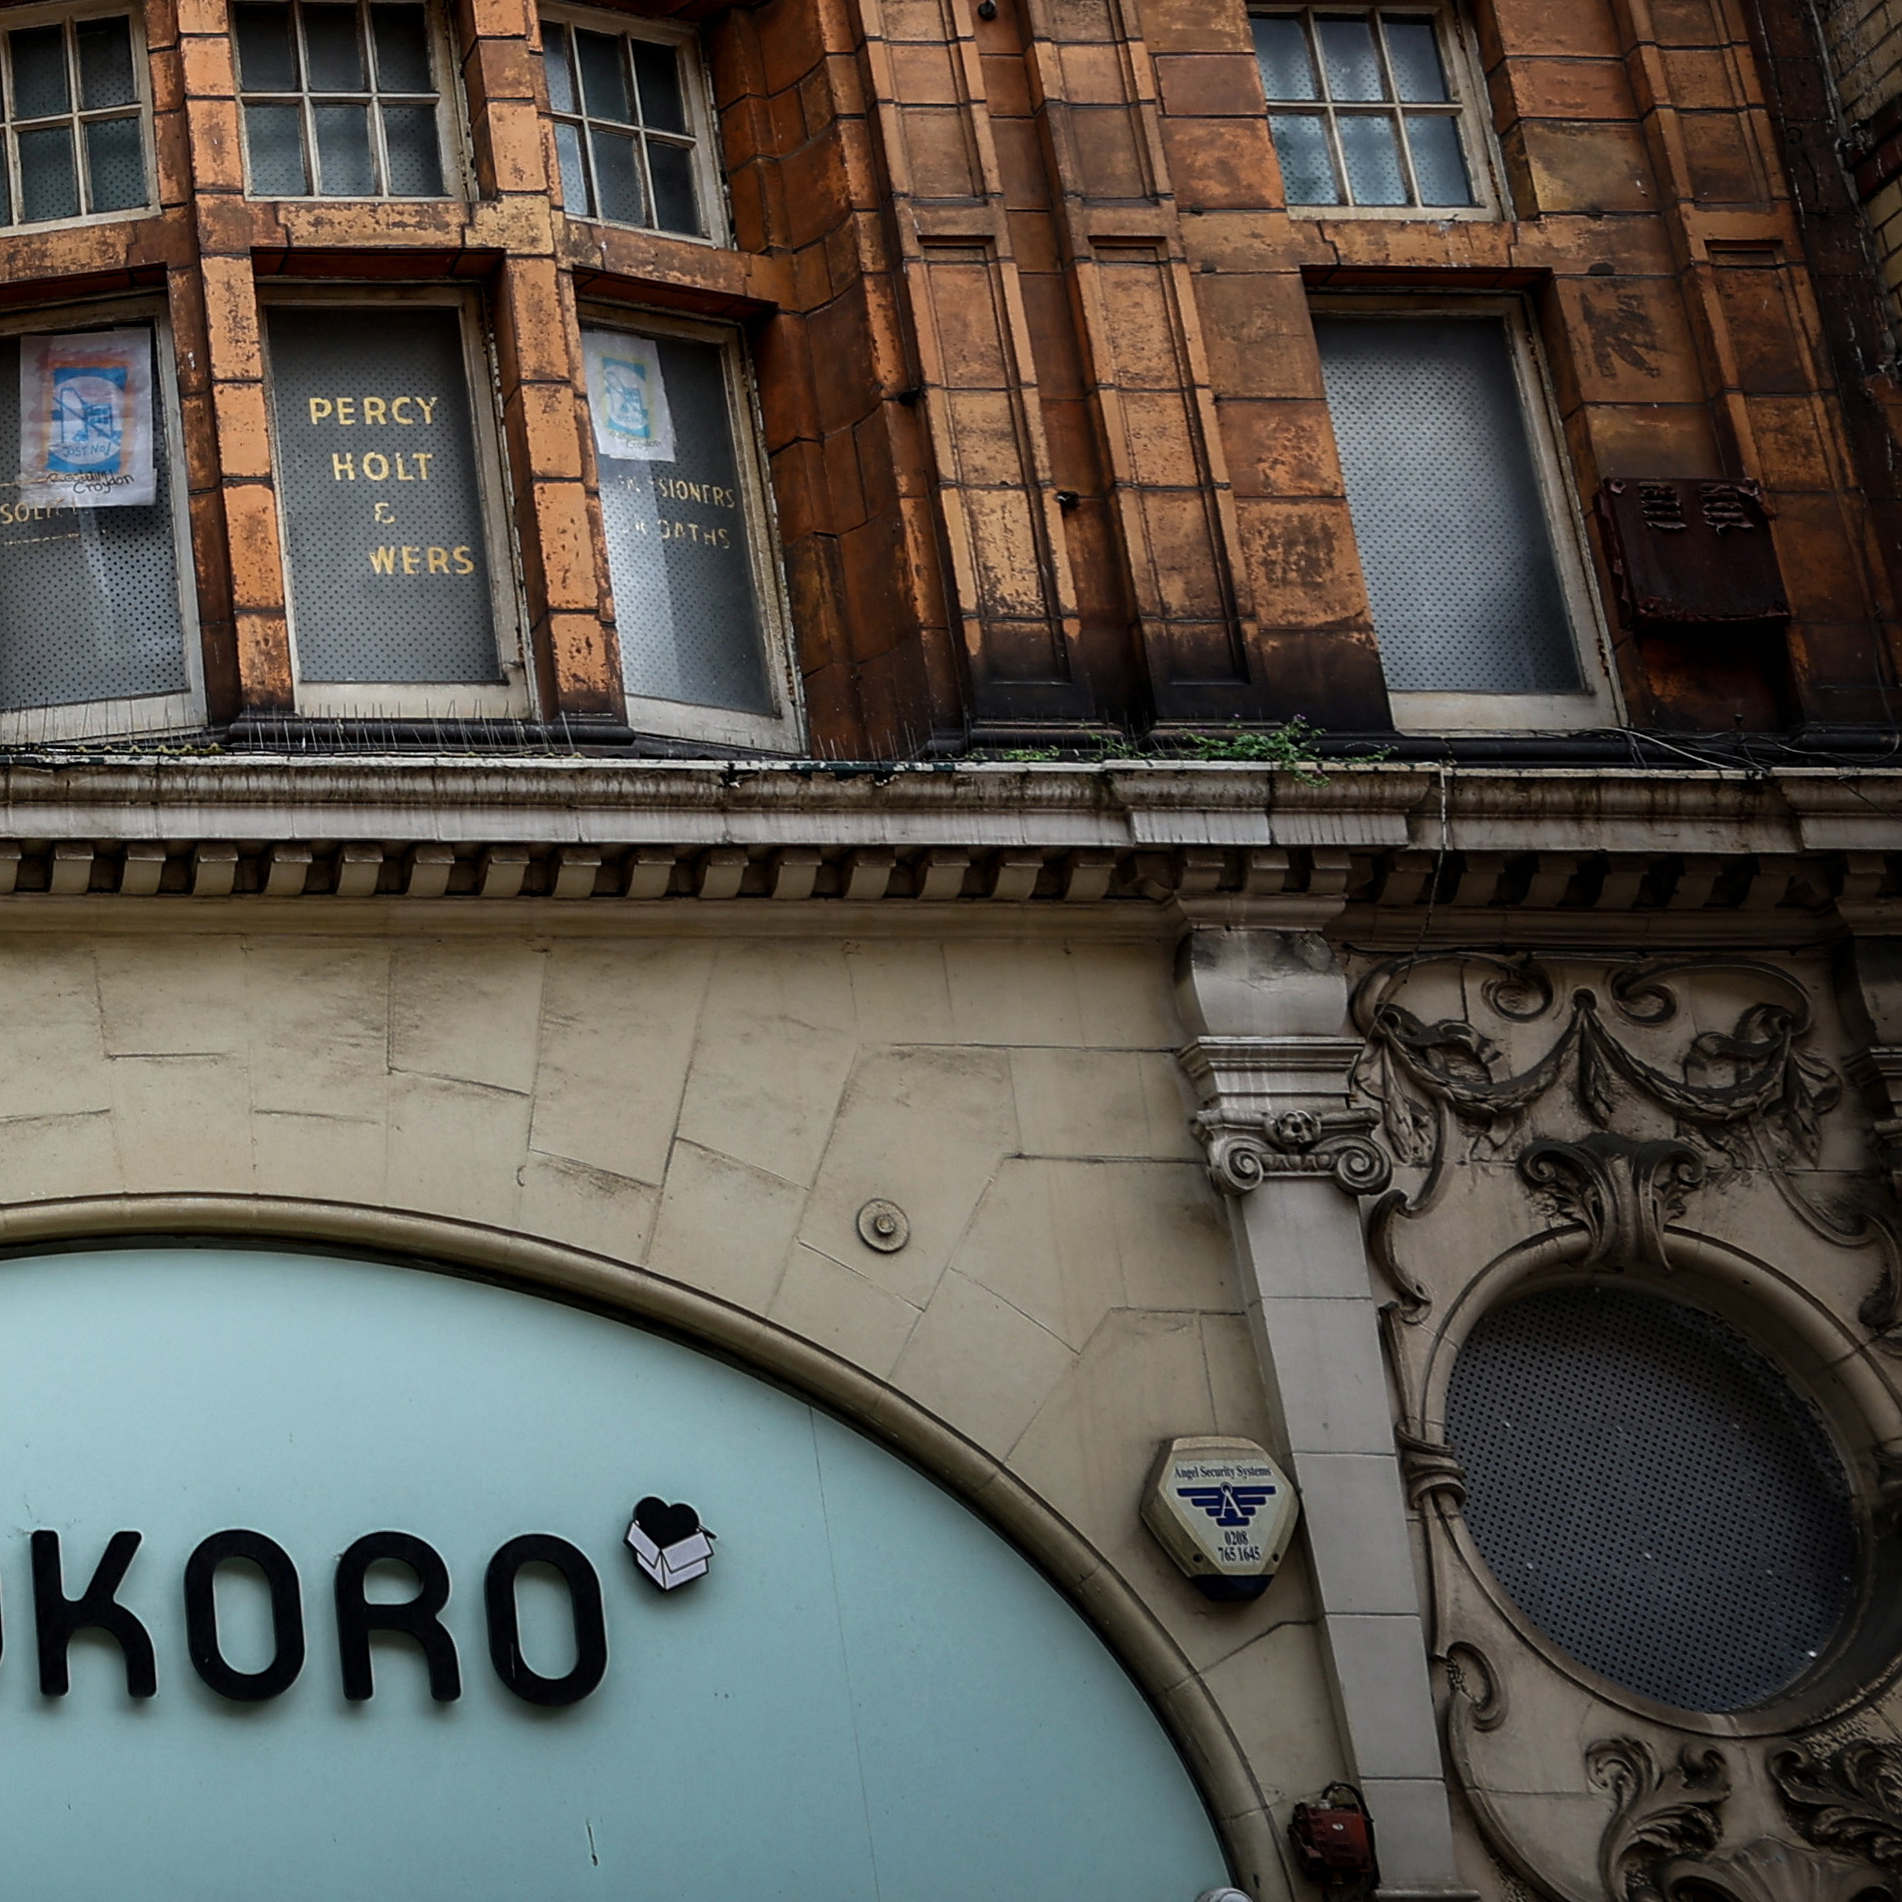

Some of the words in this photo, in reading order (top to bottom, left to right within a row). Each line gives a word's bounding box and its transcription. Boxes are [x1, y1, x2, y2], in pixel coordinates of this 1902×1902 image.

[309, 396, 438, 425] PERCY
[331, 452, 434, 481] HOLT
[369, 545, 476, 575] WERS
[1174, 1466, 1199, 1481] Angel
[1200, 1466, 1235, 1480] Security
[1236, 1465, 1272, 1479] Systems
[1225, 1531, 1249, 1546] 0208
[1218, 1547, 1236, 1562] 765
[1238, 1547, 1261, 1561] 1645
